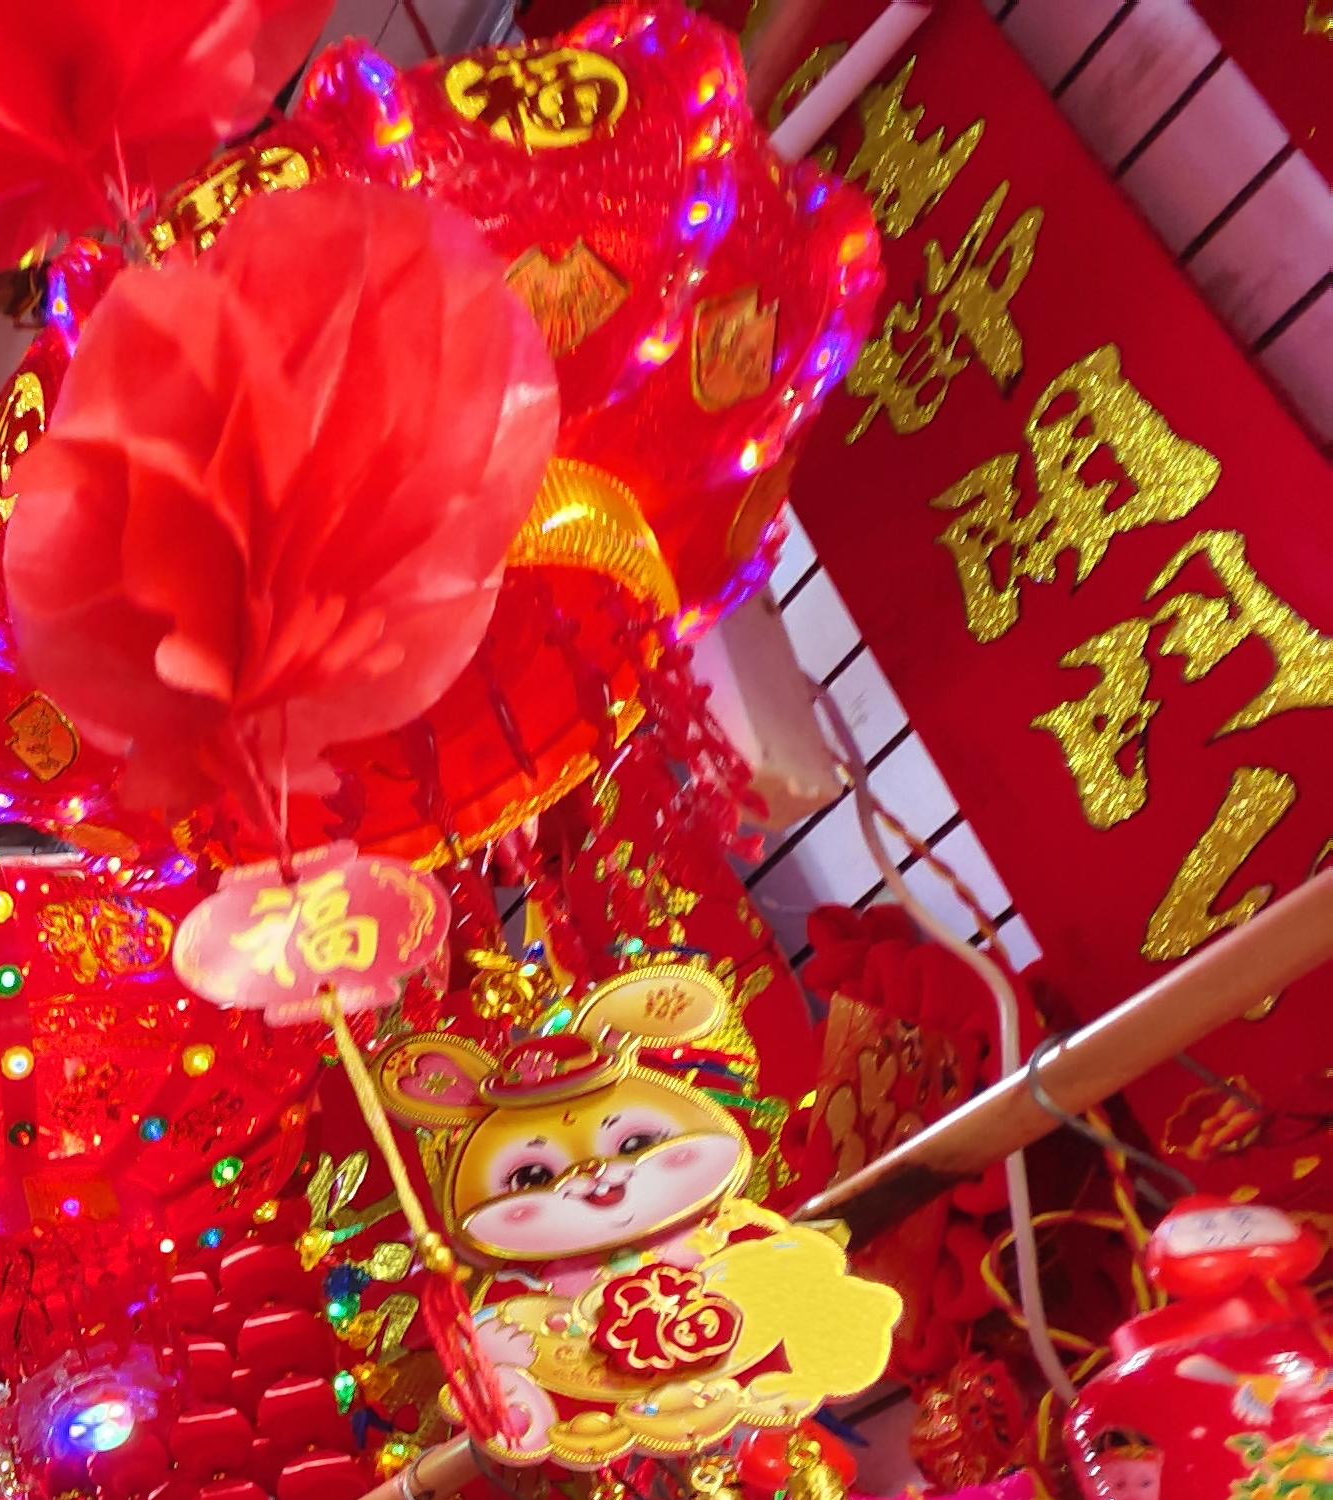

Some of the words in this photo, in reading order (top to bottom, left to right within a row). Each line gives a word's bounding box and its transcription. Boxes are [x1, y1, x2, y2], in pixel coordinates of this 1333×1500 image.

[453, 44, 623, 147] 福
[230, 870, 379, 988] 福
[606, 1265, 743, 1370] 福
